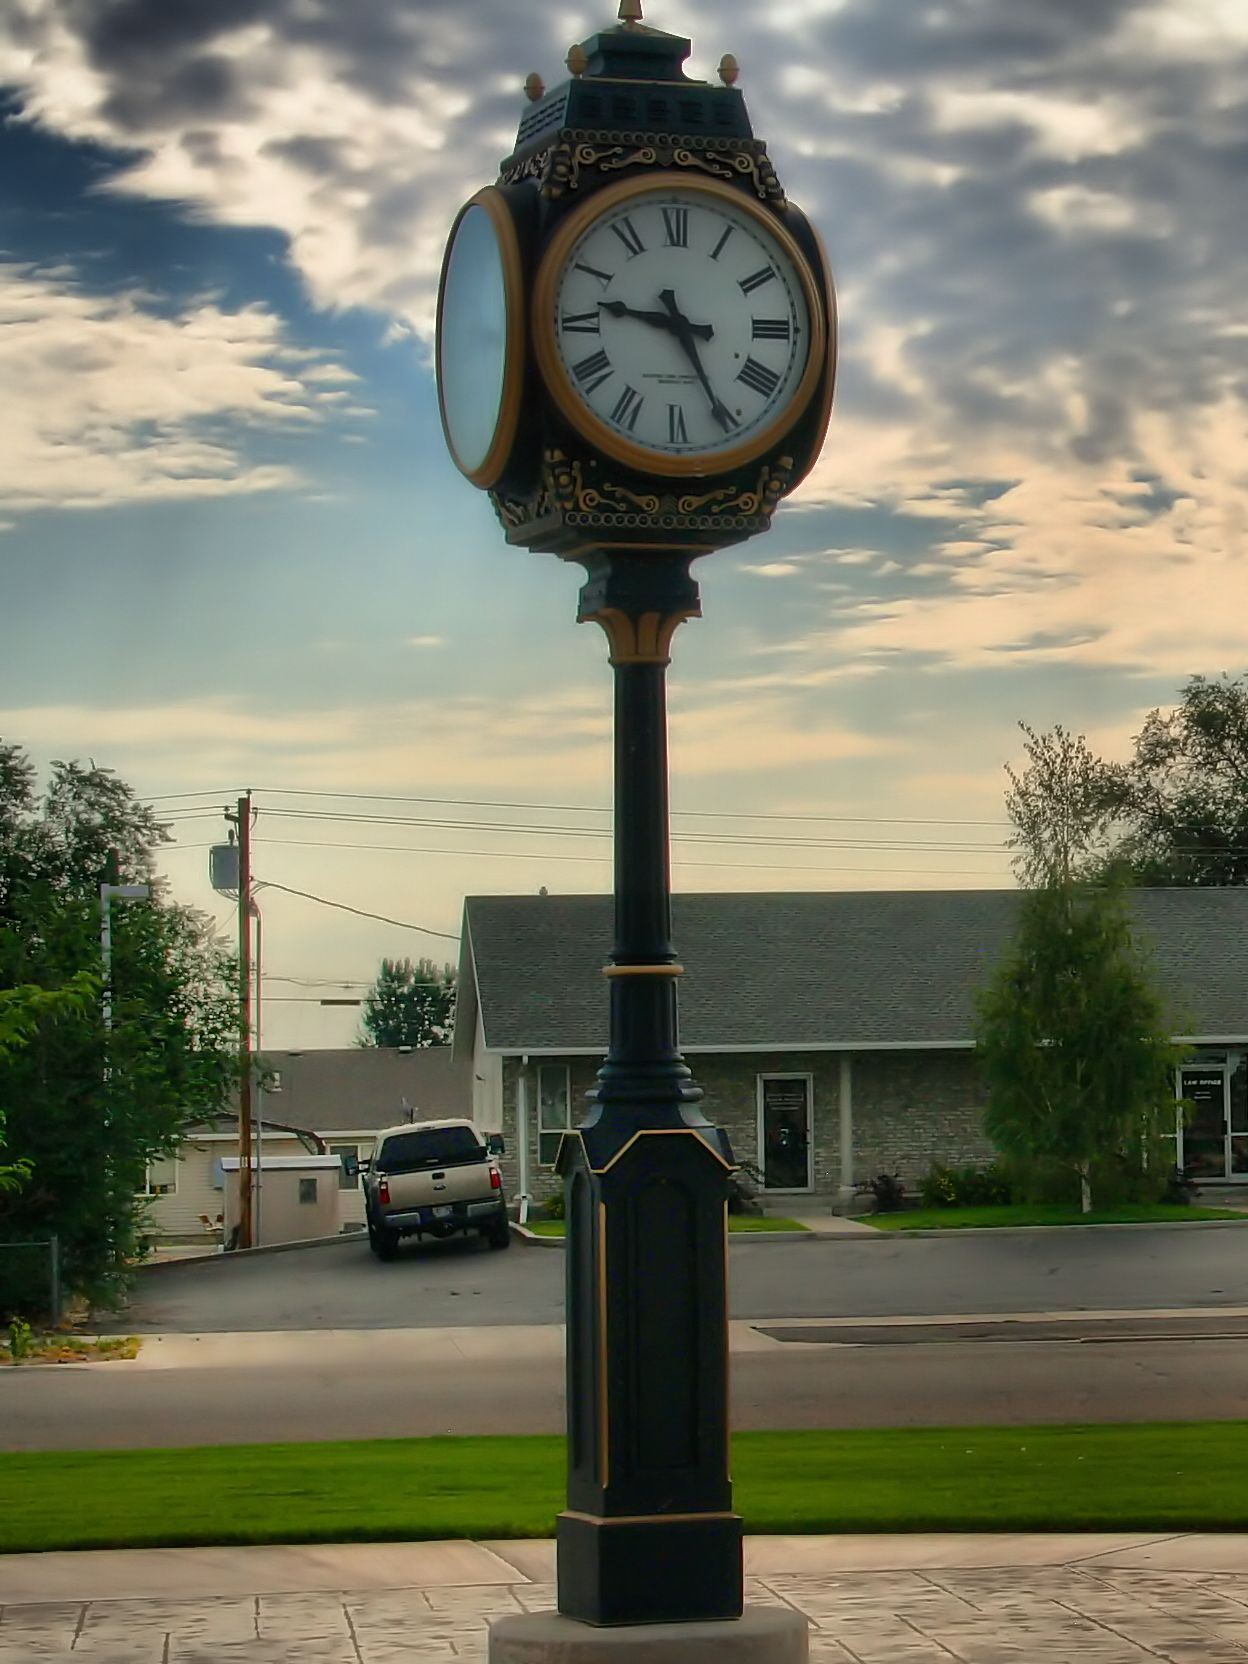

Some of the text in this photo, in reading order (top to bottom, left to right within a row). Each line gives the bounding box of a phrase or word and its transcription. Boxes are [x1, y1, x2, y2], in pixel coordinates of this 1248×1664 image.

[609, 216, 648, 262] XI
[660, 207, 690, 248] XII
[709, 223, 737, 261] I
[572, 262, 615, 293] X
[736, 263, 778, 295] II
[562, 308, 601, 336] IX
[751, 318, 791, 341] III
[571, 347, 615, 396] VIII
[735, 354, 782, 399] IIII
[610, 384, 646, 433] VII
[665, 403, 694, 444] VI
